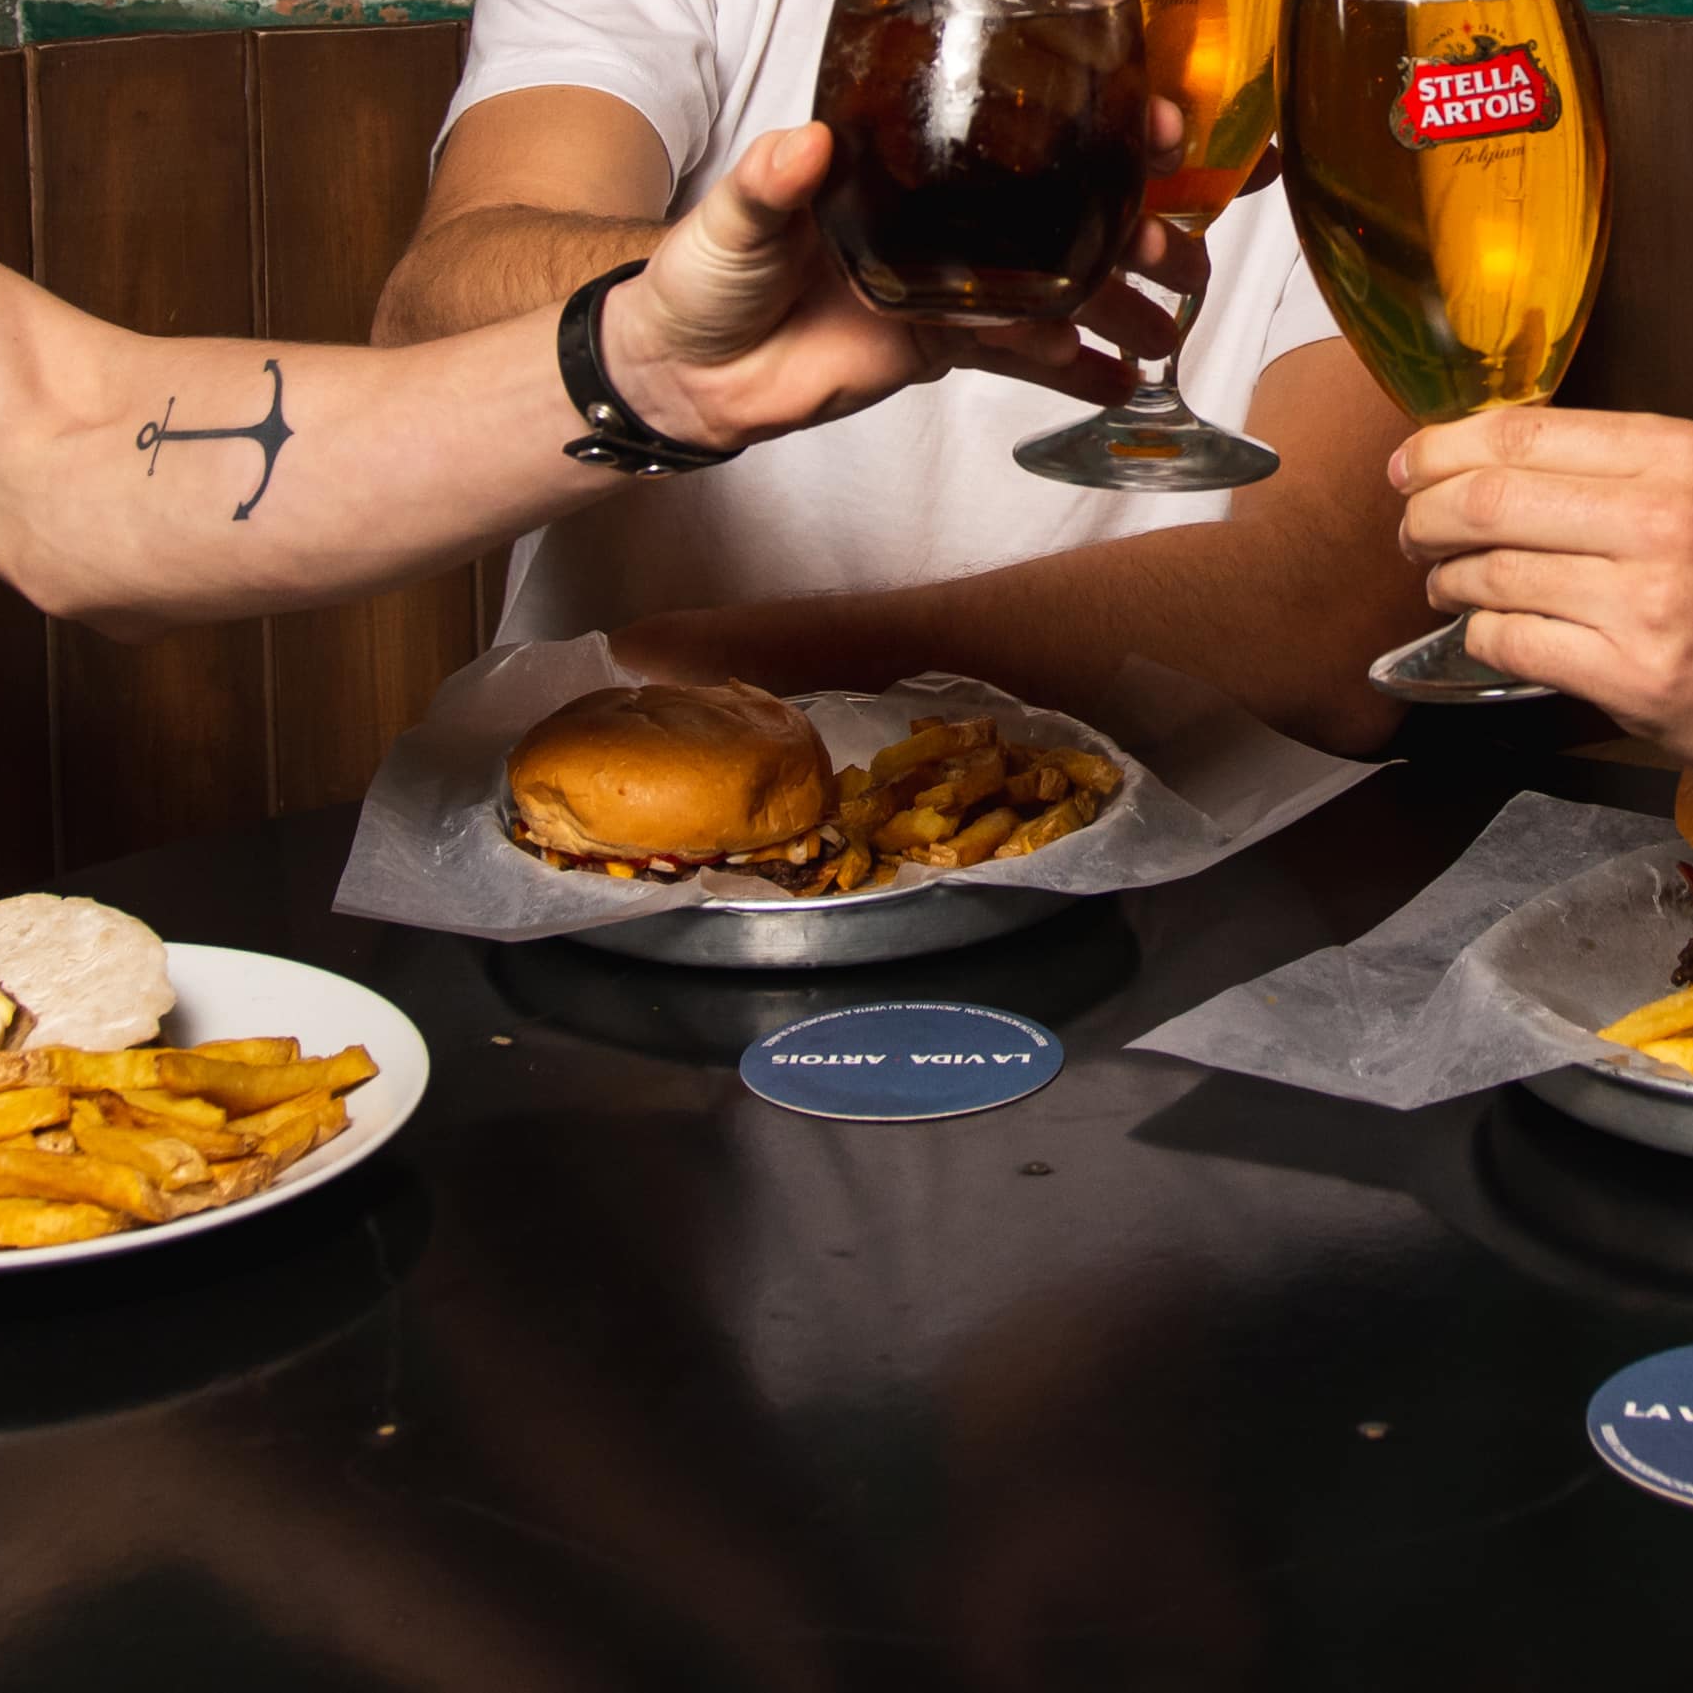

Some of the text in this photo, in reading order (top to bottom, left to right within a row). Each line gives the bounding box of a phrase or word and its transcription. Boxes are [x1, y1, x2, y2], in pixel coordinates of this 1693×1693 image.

[1418, 64, 1530, 102] STELLA
[1420, 89, 1536, 128] ARTOIS
[1454, 145, 1525, 169] Belgium
[771, 1053, 1031, 1065] LA VIDA ARTOIS
[1623, 1401, 1671, 1421] LA
